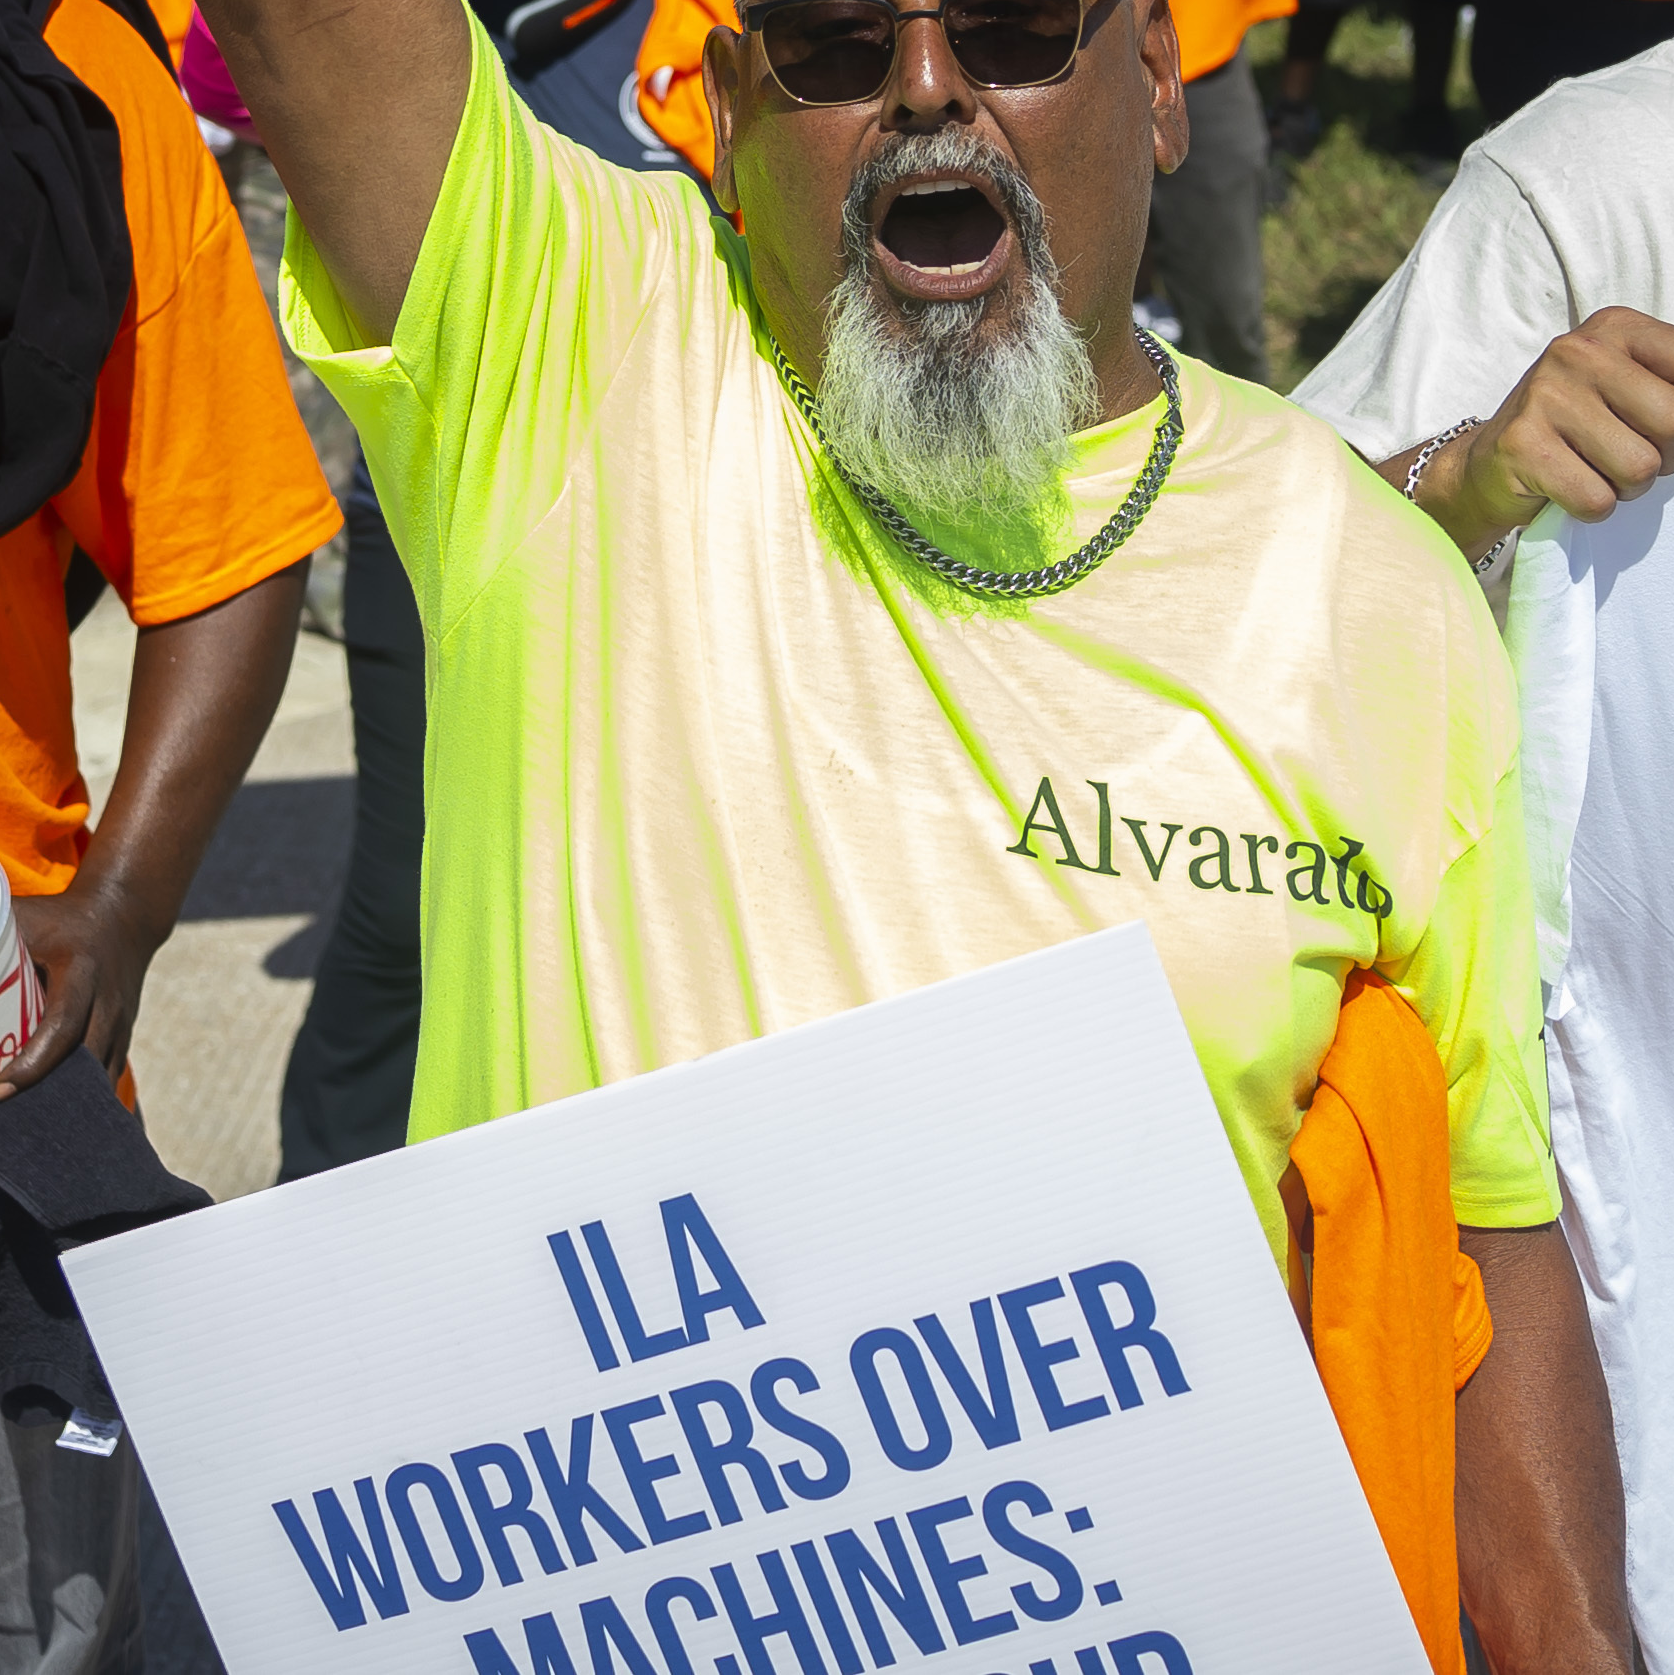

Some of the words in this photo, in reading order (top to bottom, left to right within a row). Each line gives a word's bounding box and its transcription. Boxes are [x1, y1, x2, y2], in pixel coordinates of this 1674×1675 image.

[546, 1192, 766, 1373] ILA
[271, 1356, 852, 1632] WORKERS
[849, 1260, 1193, 1473] OVER
